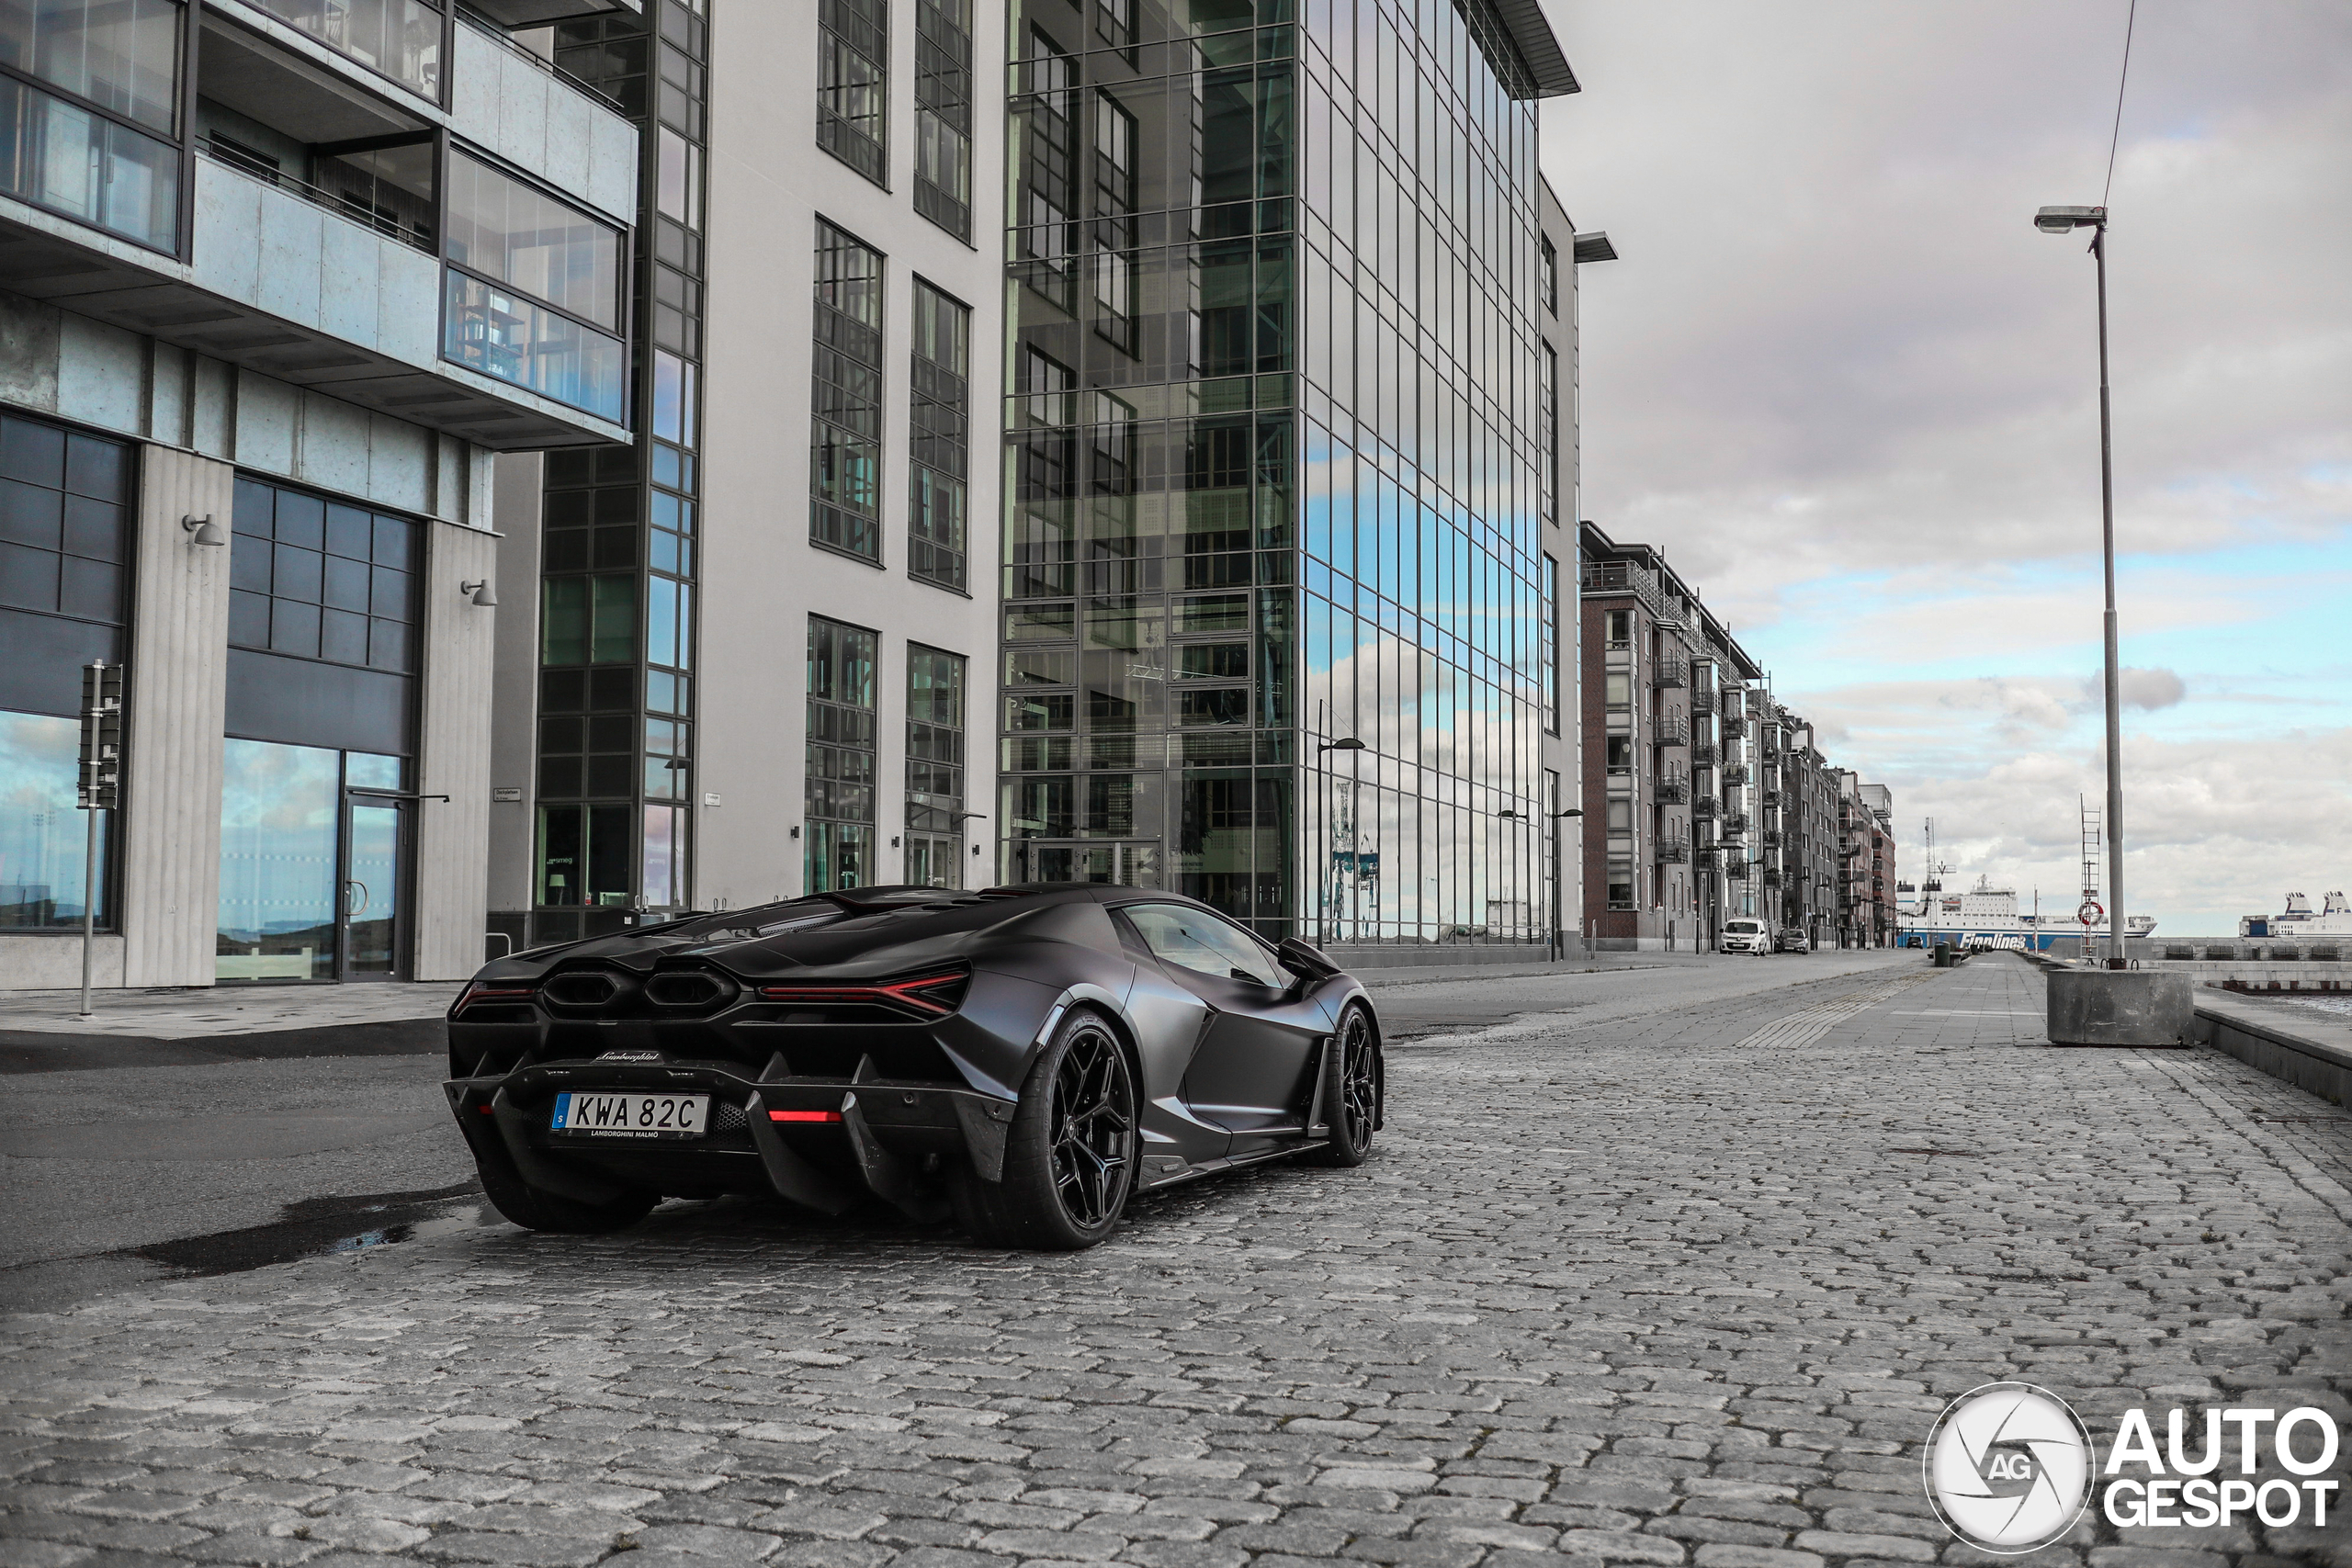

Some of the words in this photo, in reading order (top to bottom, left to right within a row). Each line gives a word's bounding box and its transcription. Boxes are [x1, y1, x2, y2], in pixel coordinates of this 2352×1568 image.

[1960, 933, 2026, 949] Finnlines
[595, 1051, 660, 1063] Lamborghini
[557, 1114, 564, 1123] S
[575, 1097, 628, 1126] KWA
[639, 1098, 695, 1128] 82C
